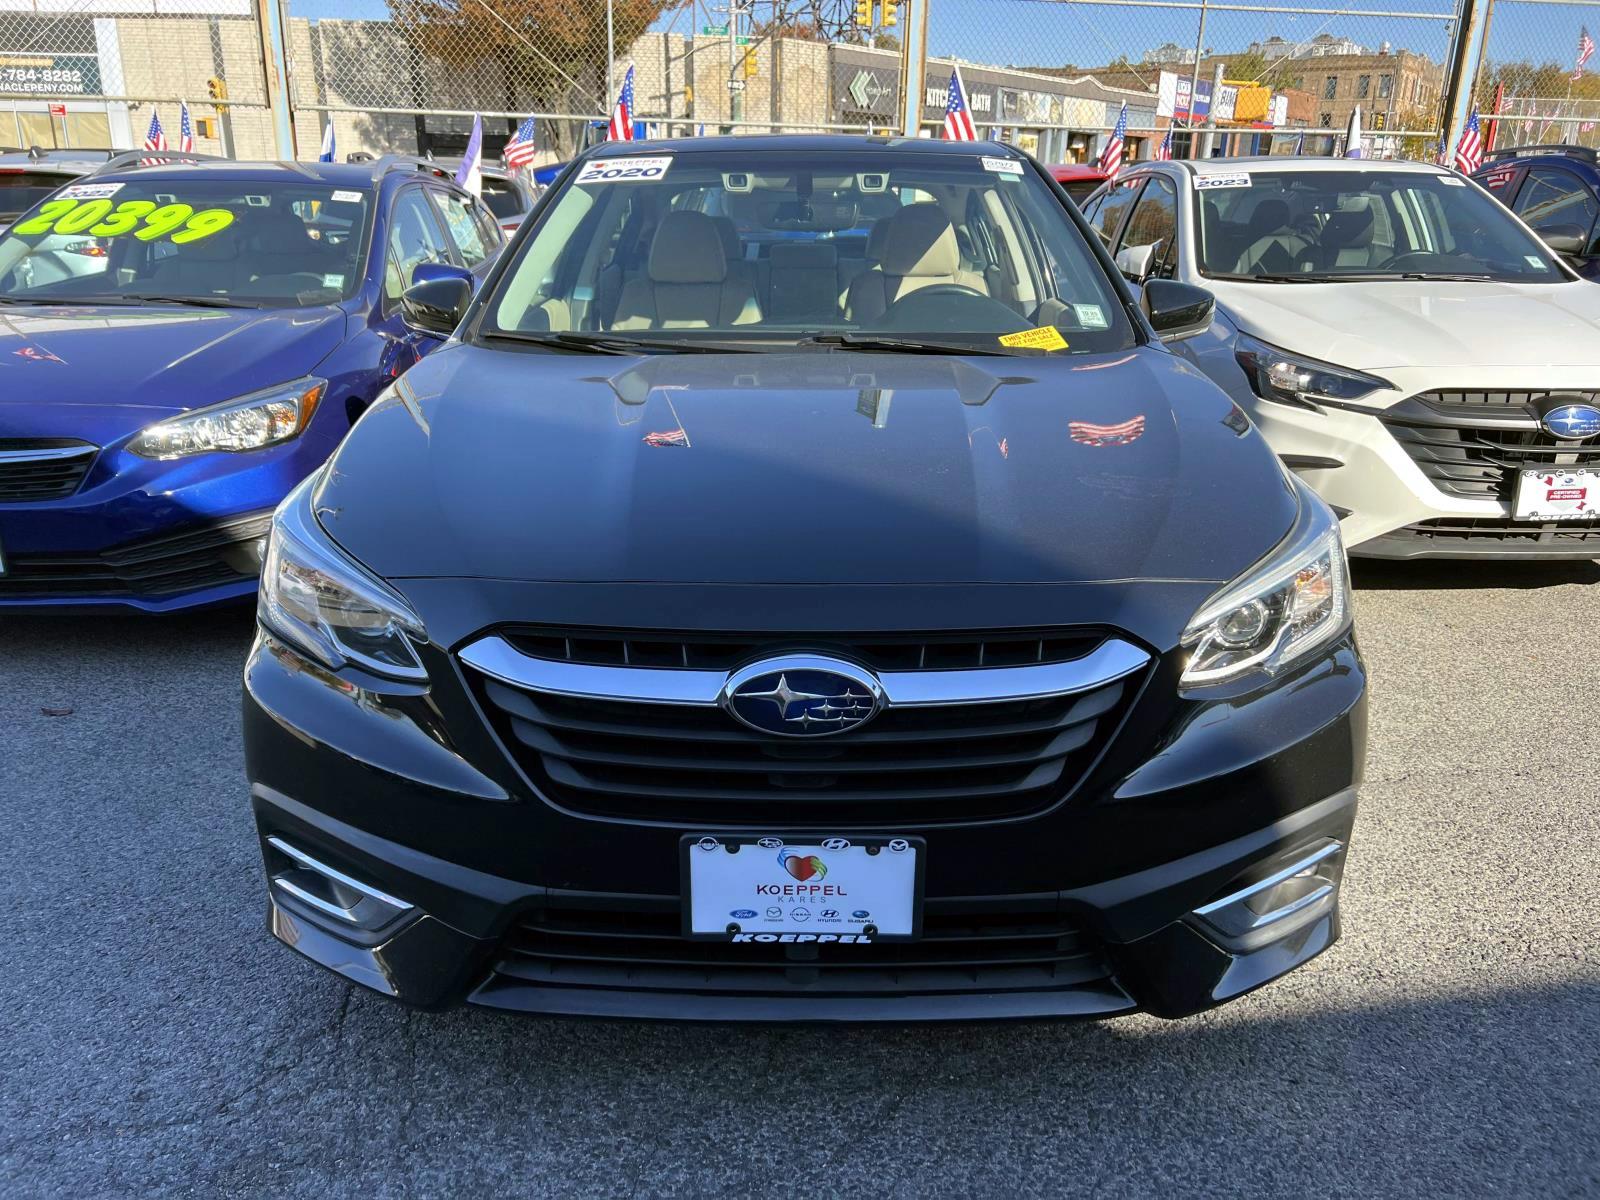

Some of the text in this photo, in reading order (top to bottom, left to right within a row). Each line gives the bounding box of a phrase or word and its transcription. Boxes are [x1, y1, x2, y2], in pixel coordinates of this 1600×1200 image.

[971, 93, 991, 112] BATH
[579, 167, 663, 181] 2020
[1197, 178, 1249, 188] 2023
[13, 199, 235, 244] 20399
[1003, 327, 1053, 343] THIS VEHICLE
[756, 884, 848, 896] KOEPPEL
[777, 896, 827, 904] KARES
[731, 932, 872, 944] KOEPPEL
